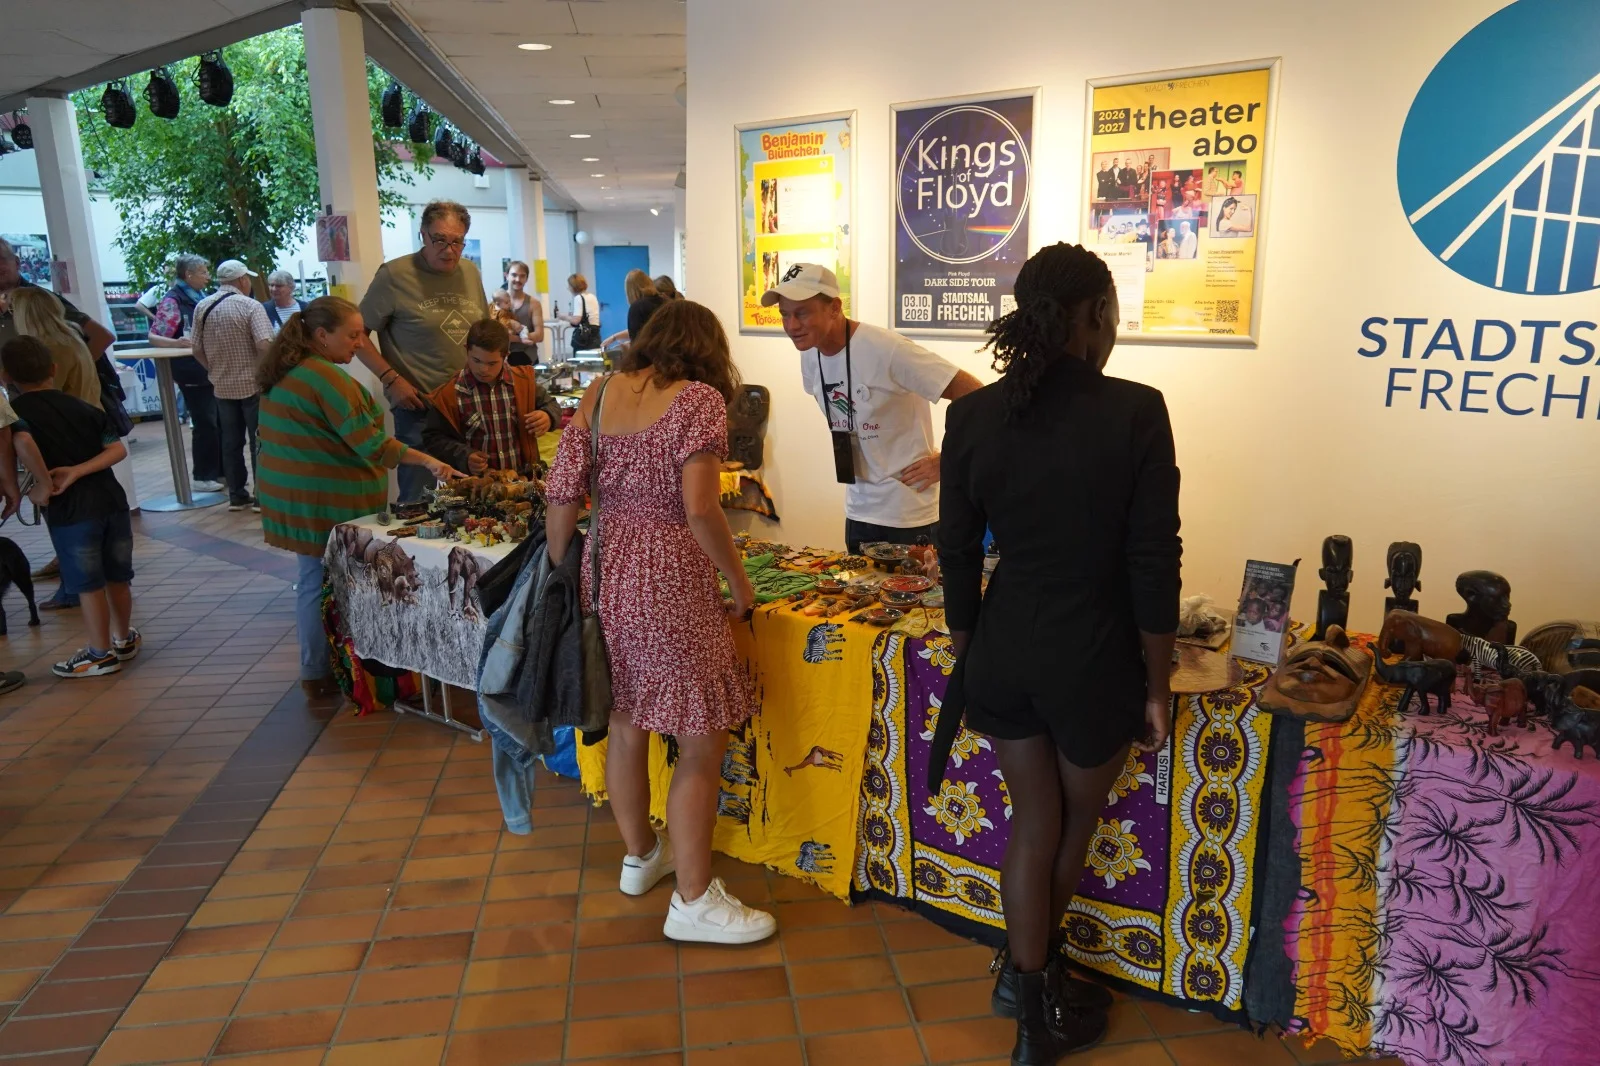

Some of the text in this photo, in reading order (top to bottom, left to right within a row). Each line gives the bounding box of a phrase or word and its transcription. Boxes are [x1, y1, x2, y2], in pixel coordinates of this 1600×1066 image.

[1098, 109, 1126, 121] 2026
[1133, 100, 1261, 131] theater
[1098, 122, 1125, 134] 2027
[762, 132, 824, 151] Benjamin
[1192, 130, 1258, 157] abo
[768, 145, 820, 160] Blümchen
[916, 135, 1016, 178] Kings
[958, 169, 972, 183] of
[916, 170, 1014, 218] Floyd
[924, 278, 996, 287] DARK SIDE TOUR
[417, 297, 440, 310] KEEP
[441, 296, 458, 304] THE
[903, 296, 931, 308] 03.10.
[942, 292, 990, 304] STADTSAAL
[905, 308, 929, 320] 2026
[937, 304, 994, 321] FRECHEN
[1357, 316, 1600, 366] STADTS
[1384, 367, 1600, 420] FRECH
[1157, 755, 1169, 796] HARUSI
